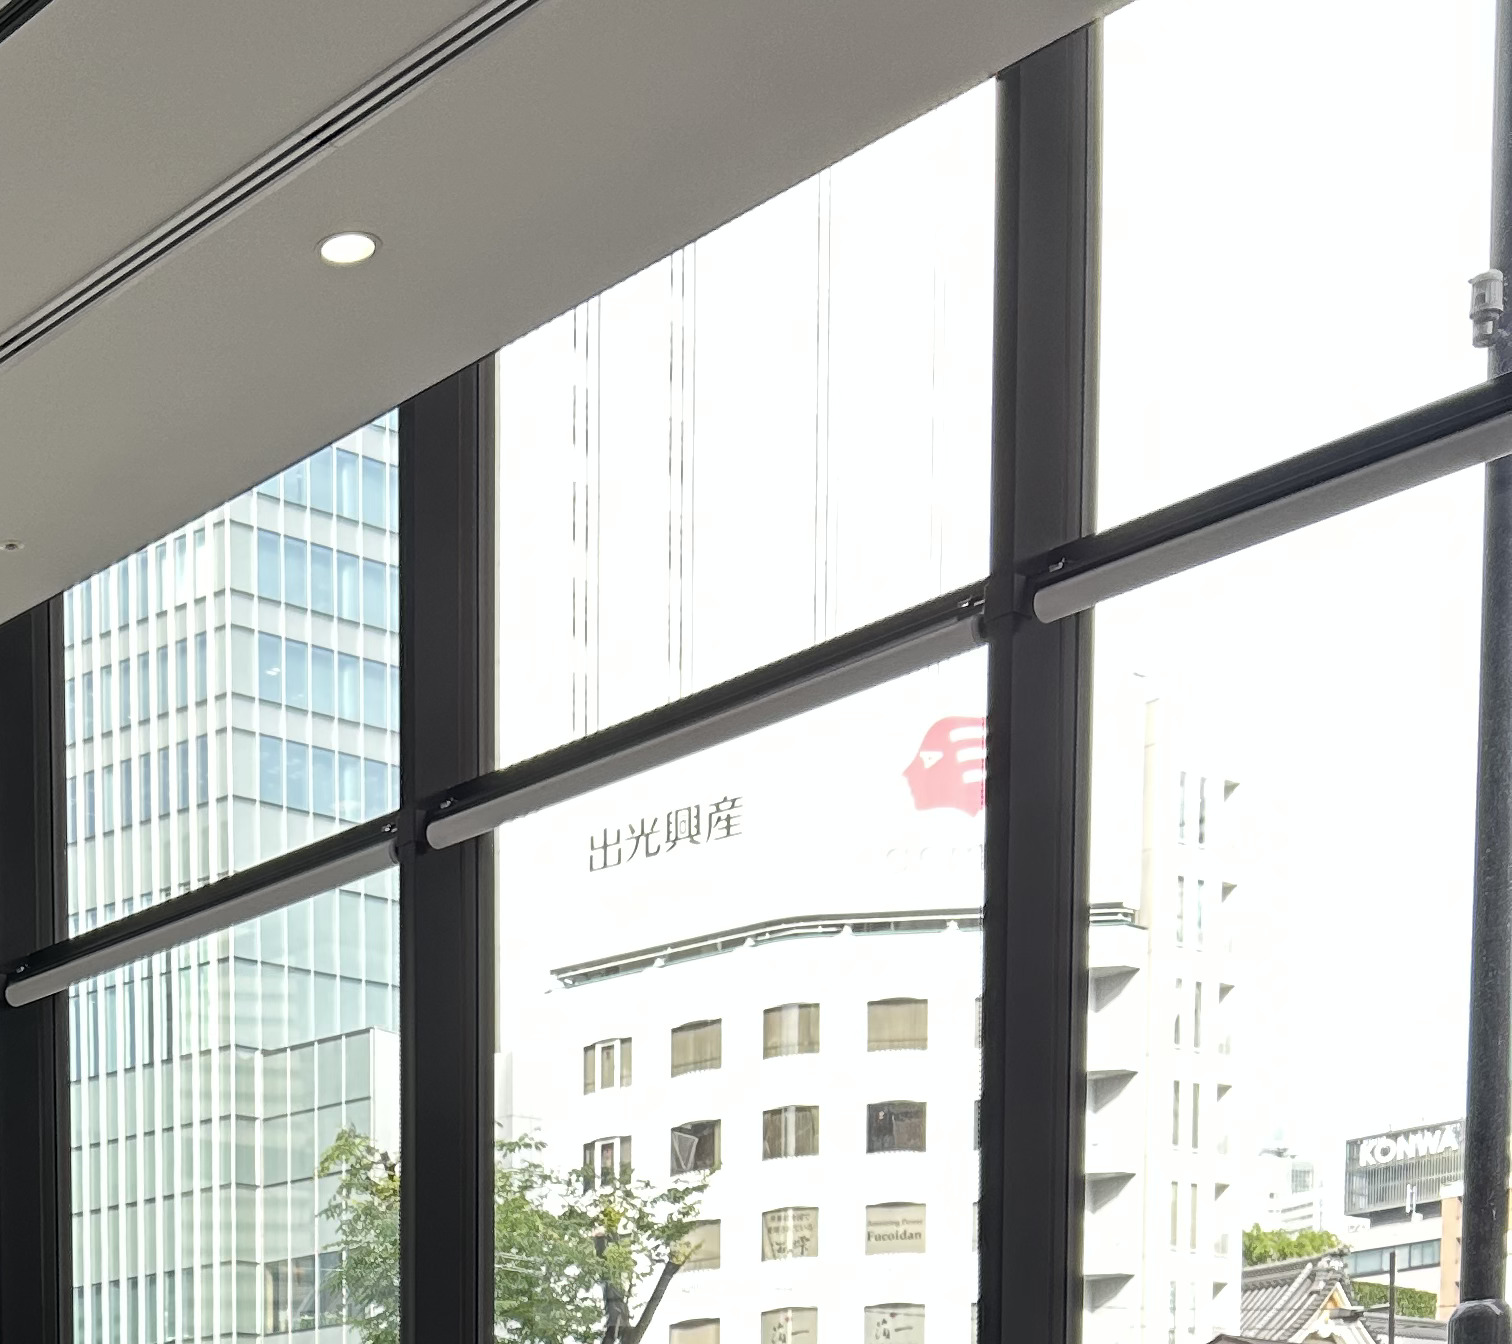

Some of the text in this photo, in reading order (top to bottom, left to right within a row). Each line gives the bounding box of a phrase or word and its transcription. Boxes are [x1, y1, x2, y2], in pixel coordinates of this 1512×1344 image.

[589, 795, 743, 872] 出光興産
[867, 1229, 922, 1242] Fucoidan
